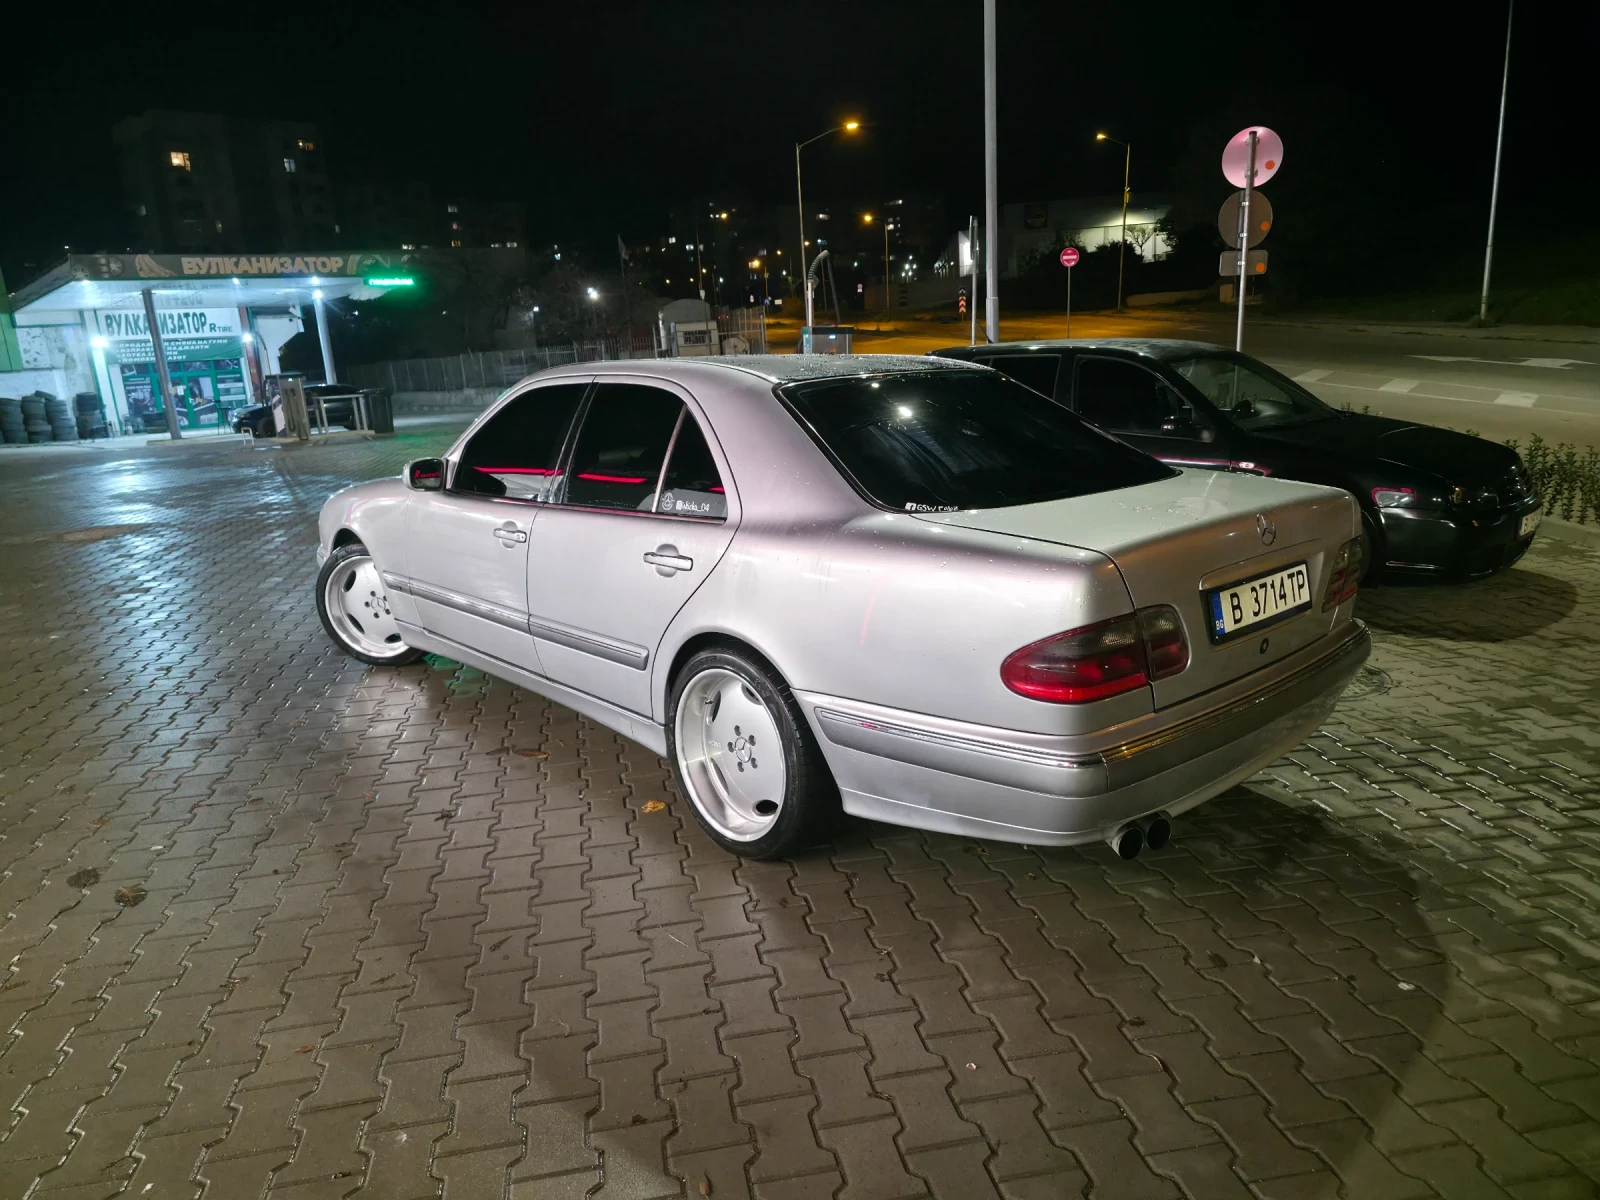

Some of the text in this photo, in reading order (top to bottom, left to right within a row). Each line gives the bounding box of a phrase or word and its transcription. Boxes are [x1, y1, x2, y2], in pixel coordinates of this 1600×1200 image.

[181, 257, 344, 275] ВУЛКАНИЗАТОР
[105, 312, 207, 336] ВУЛКАИЗАТОР
[1229, 591, 1243, 625] B
[1216, 620, 1224, 630] BG
